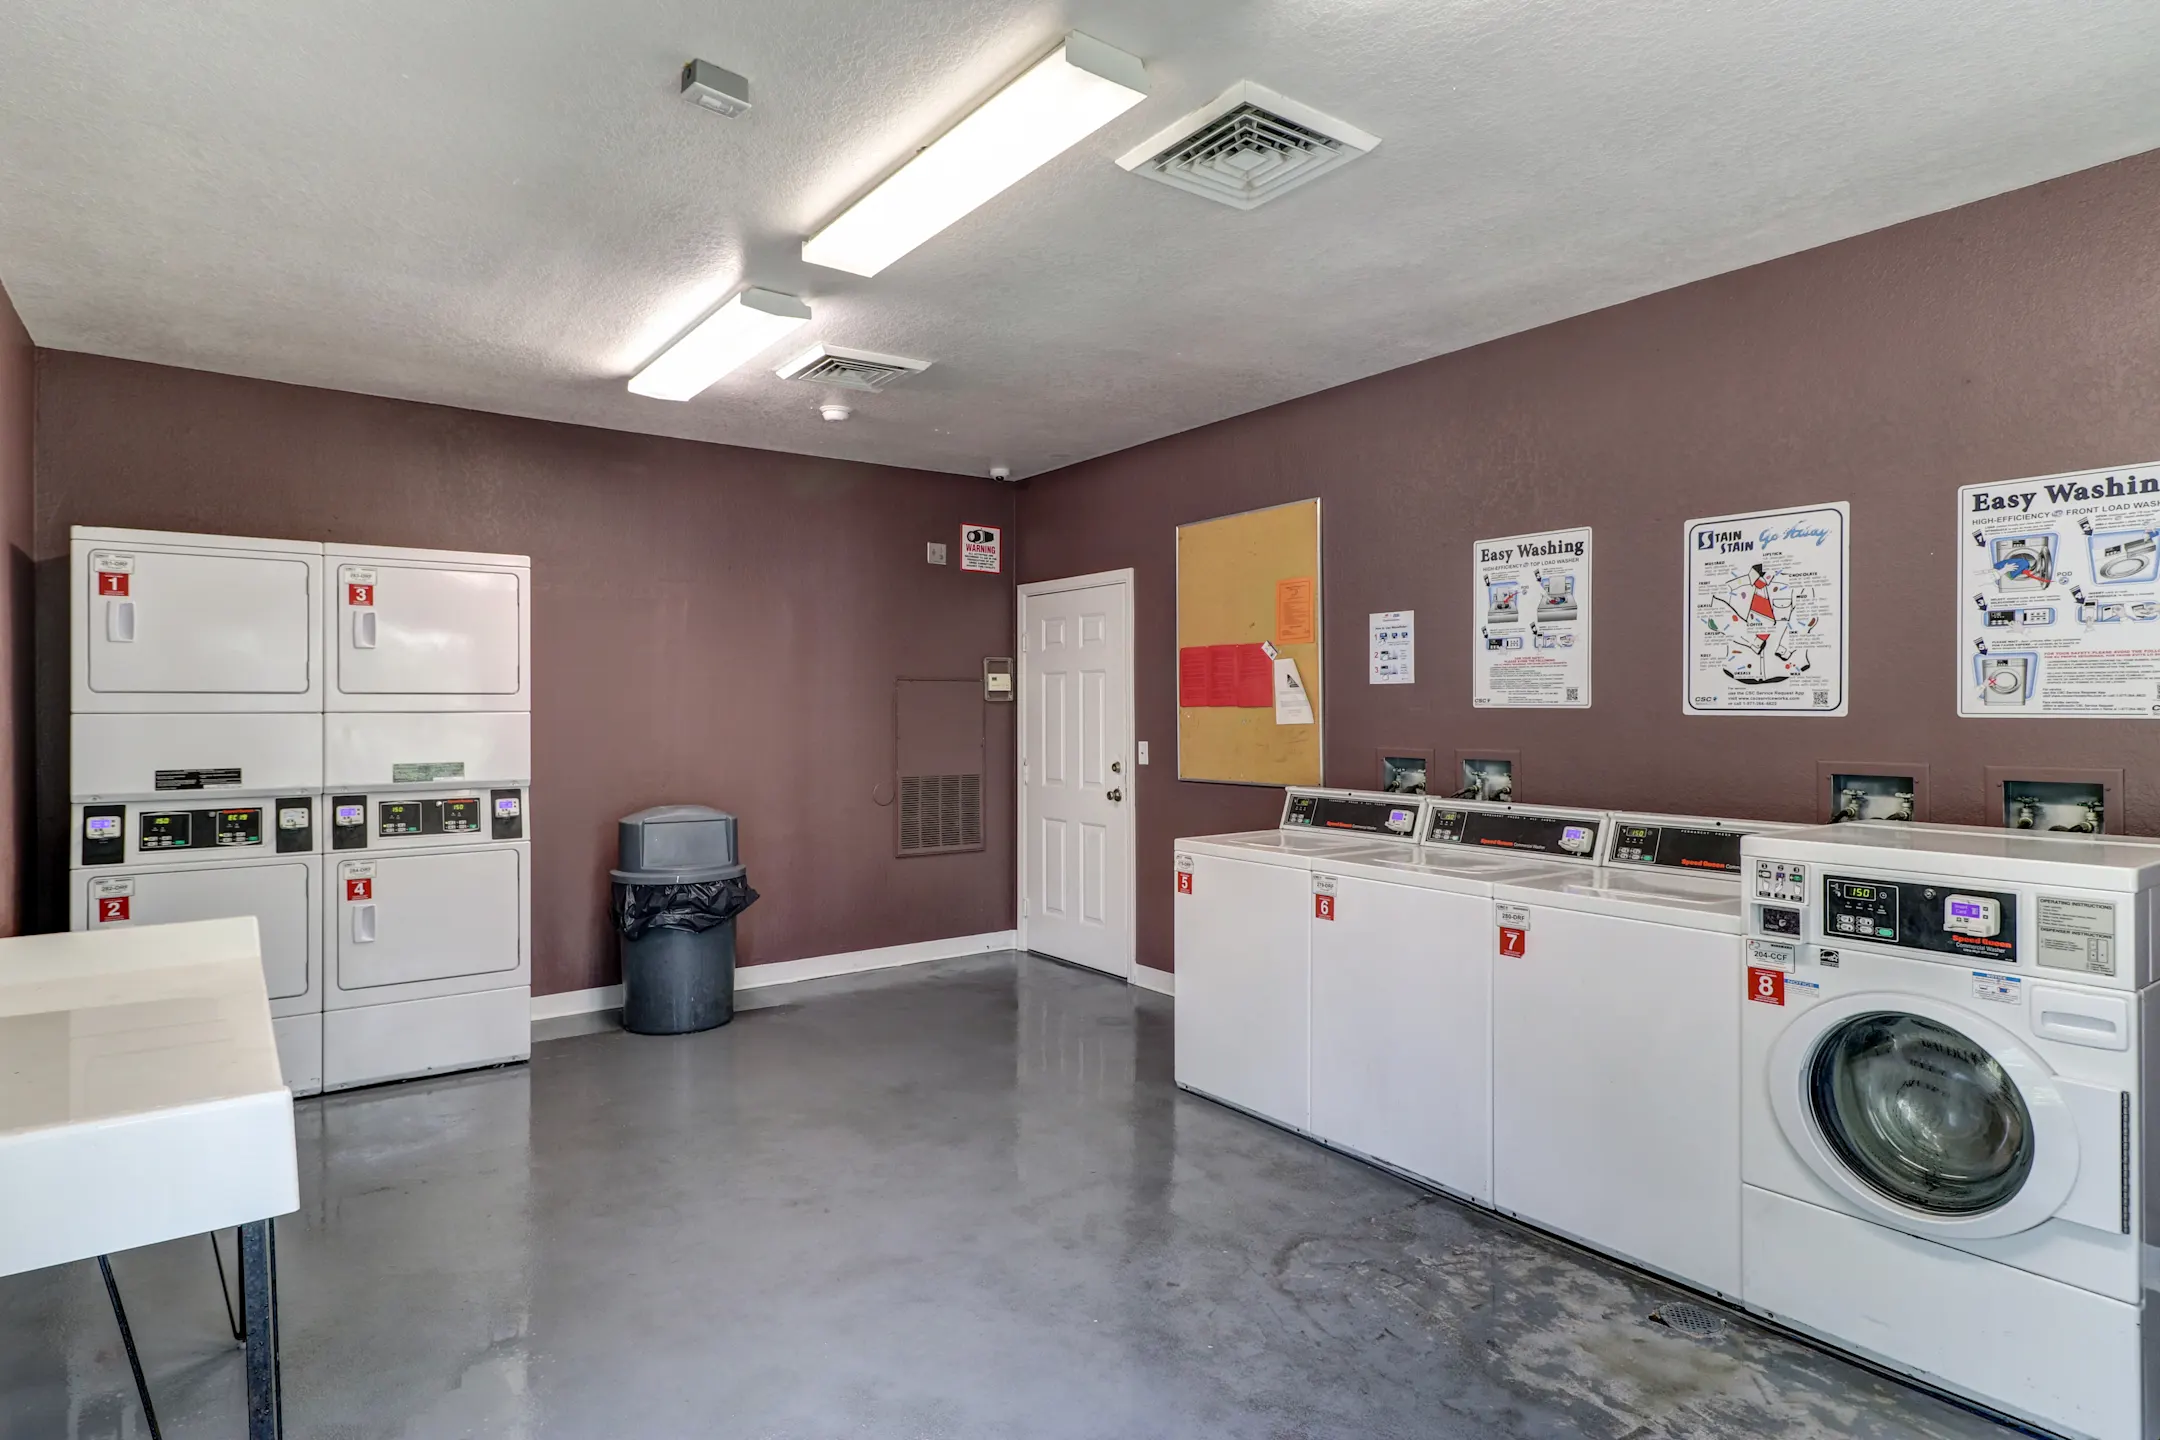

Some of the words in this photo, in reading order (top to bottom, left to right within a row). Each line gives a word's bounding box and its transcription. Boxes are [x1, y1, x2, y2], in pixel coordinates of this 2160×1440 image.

[1972, 493, 2037, 513] Easy
[1972, 512, 2050, 525] HIGH-EFFICIENCY
[2066, 506, 2099, 515] FRONT
[2102, 503, 2131, 512] LOAD
[966, 544, 996, 554] WARNING
[1480, 548, 1513, 563] Easy
[1517, 540, 1584, 556] Washing
[1720, 540, 1754, 554] STAIN
[108, 577, 118, 590] 1
[356, 588, 367, 601] 3
[1681, 858, 1703, 866] Speed
[1703, 861, 1725, 869] Queen
[354, 882, 365, 896] 4
[1181, 876, 1188, 889] 5
[1853, 888, 1870, 897] 150
[107, 902, 120, 916] 2
[1321, 900, 1329, 915] 6
[2072, 902, 2112, 910] INSTRUCTIONS
[1506, 933, 1518, 950] 7
[1952, 934, 1981, 944] Speed
[1982, 938, 2012, 948] Queen
[2072, 931, 2112, 939] INSTRUCTIONS
[1956, 942, 1985, 951] Commercial
[1754, 951, 1787, 960] 204-CCF
[1758, 975, 1774, 996] 8
